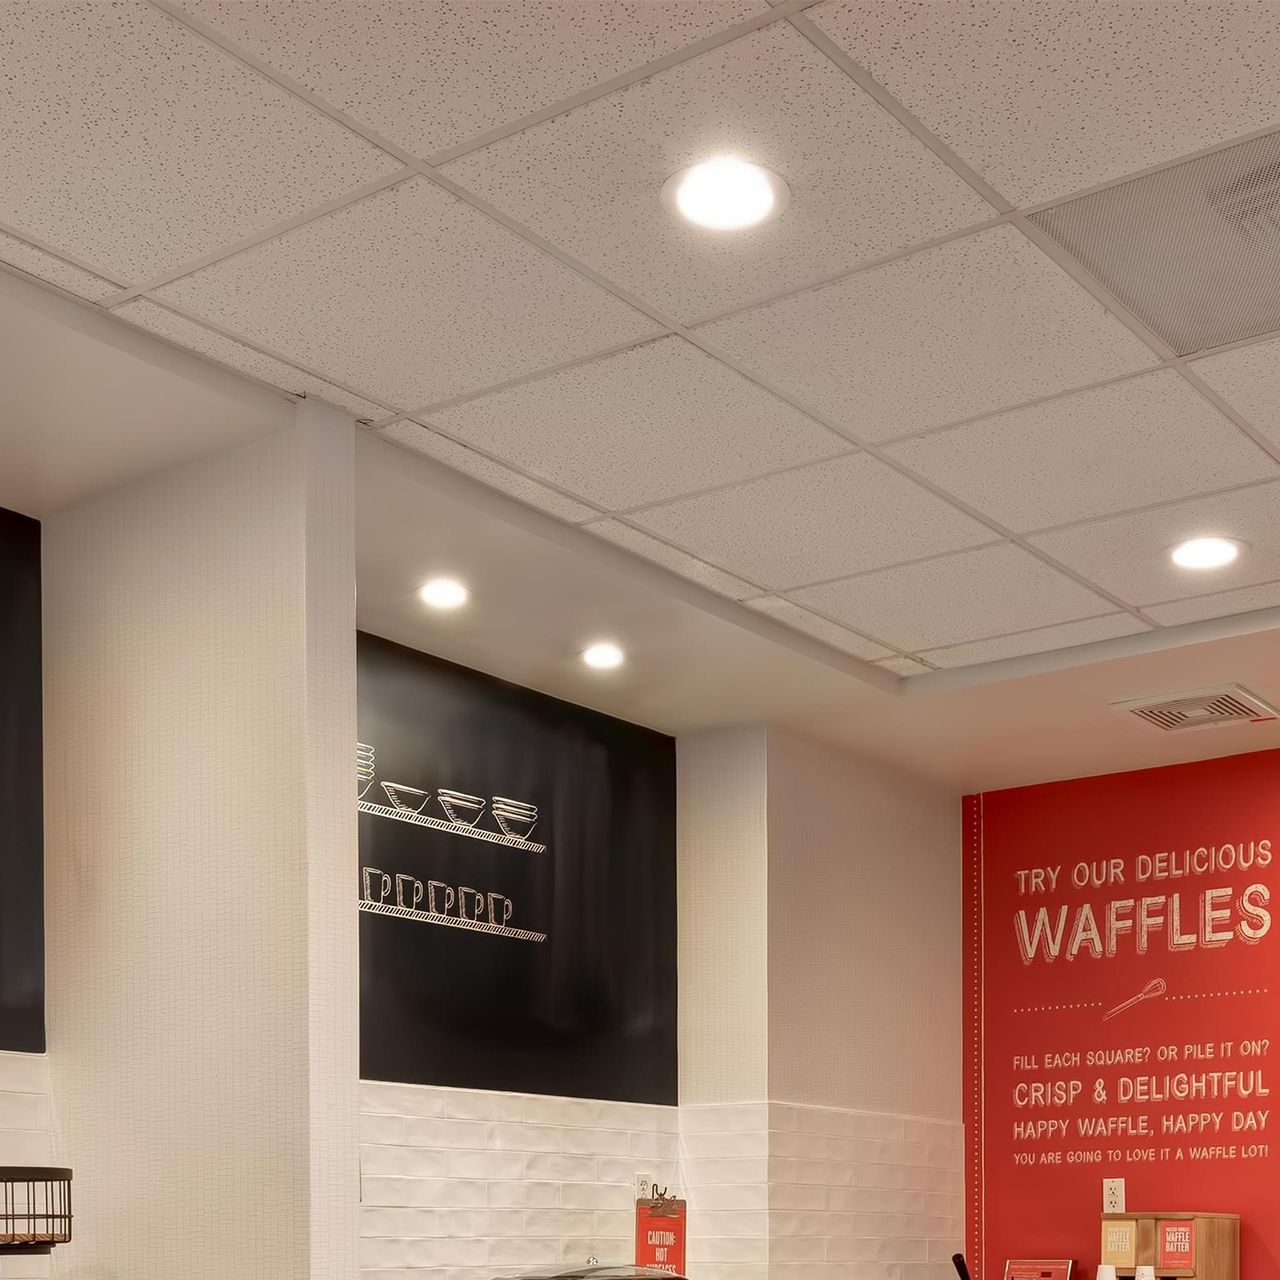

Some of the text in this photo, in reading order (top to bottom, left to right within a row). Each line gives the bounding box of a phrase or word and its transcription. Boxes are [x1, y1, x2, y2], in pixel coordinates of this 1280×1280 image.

[1015, 839, 1272, 895] TRY OUR DELICIOUS
[1014, 883, 1272, 966] WAFFLES
[1013, 1039, 1270, 1071] FILL EACH SQUARE? OR PILE IT ON?
[1013, 1069, 1270, 1108] CRISP & DELIGHTFUL
[1013, 1110, 1270, 1140] HAPPY WAFFLE, HAPPY DAY
[1014, 1144, 1269, 1165] YOU ARE GOING TO LOVE IT A WAFFLE LOT!
[647, 1230, 676, 1246] CAUTION:
[1166, 1231, 1190, 1242] WAFFLE
[1166, 1242, 1190, 1252] BATTER
[655, 1247, 668, 1262] HOT
